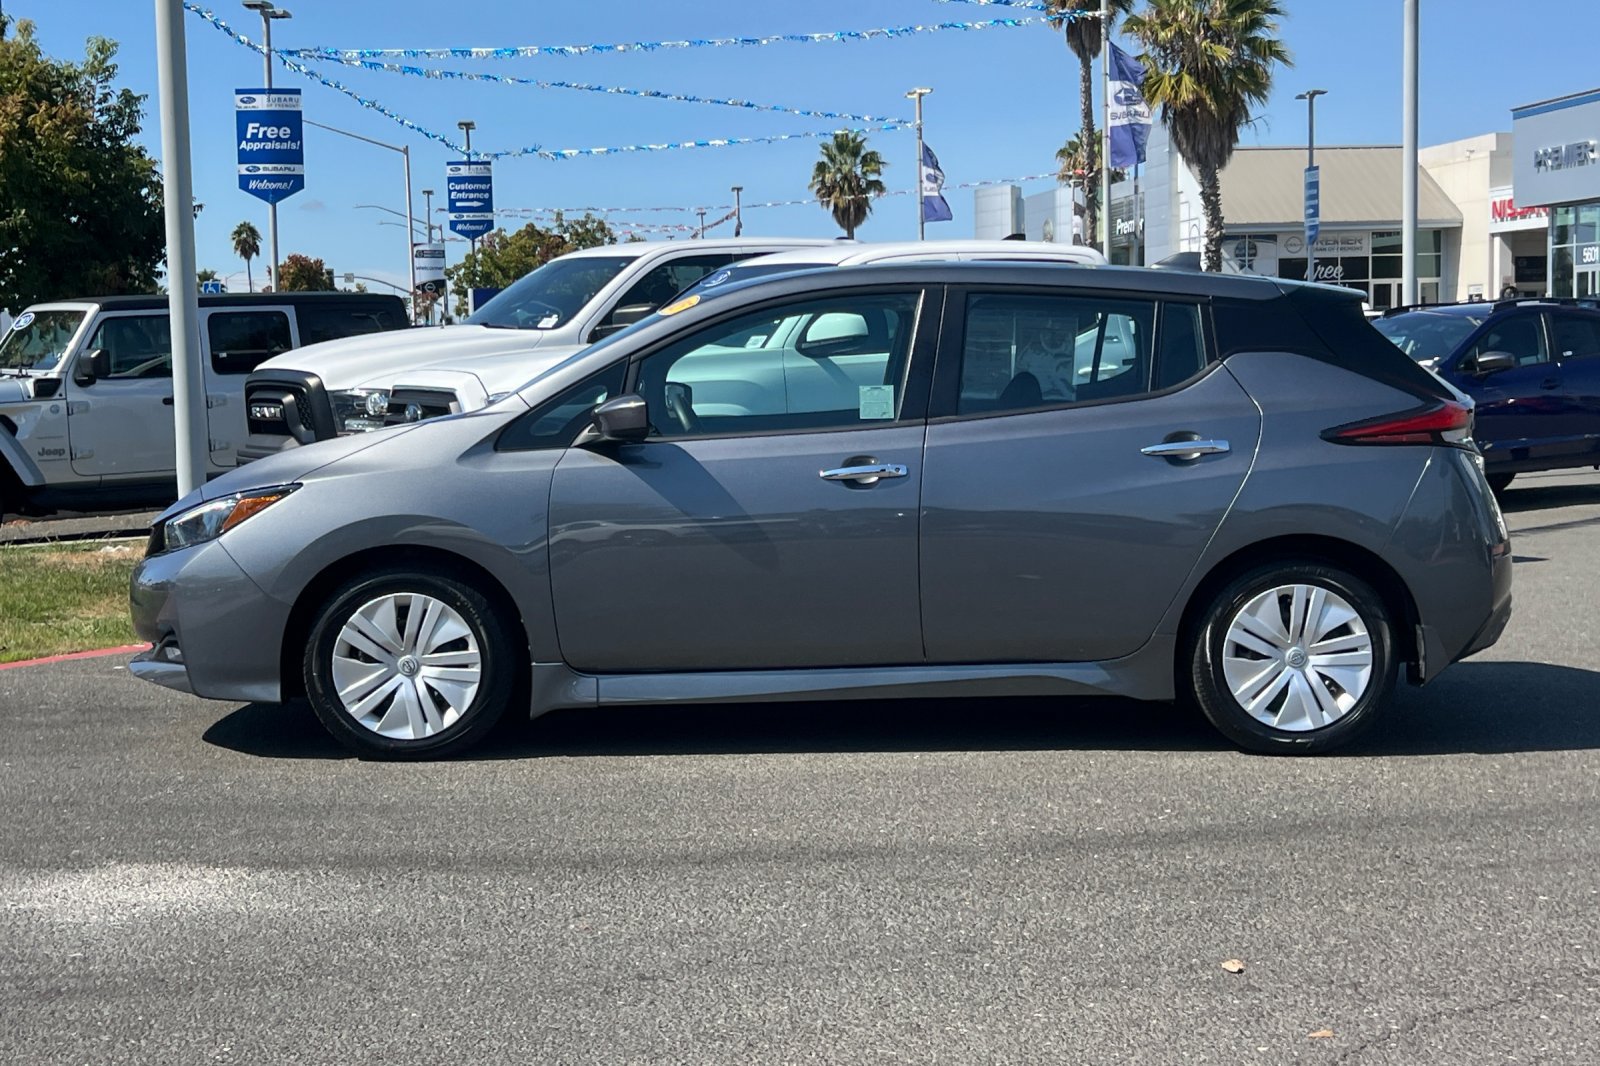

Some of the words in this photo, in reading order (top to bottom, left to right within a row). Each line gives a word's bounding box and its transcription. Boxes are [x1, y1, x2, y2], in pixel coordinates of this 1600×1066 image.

[246, 122, 291, 139] Free
[239, 140, 300, 151] Appraisals!
[1534, 141, 1597, 168] PREMIER
[248, 179, 294, 190] Welcome!
[449, 182, 491, 190] Customer
[450, 191, 490, 199] Entrance
[456, 223, 487, 231] Welcome!
[1582, 246, 1600, 262] 5601
[37, 447, 66, 457] Jeep
